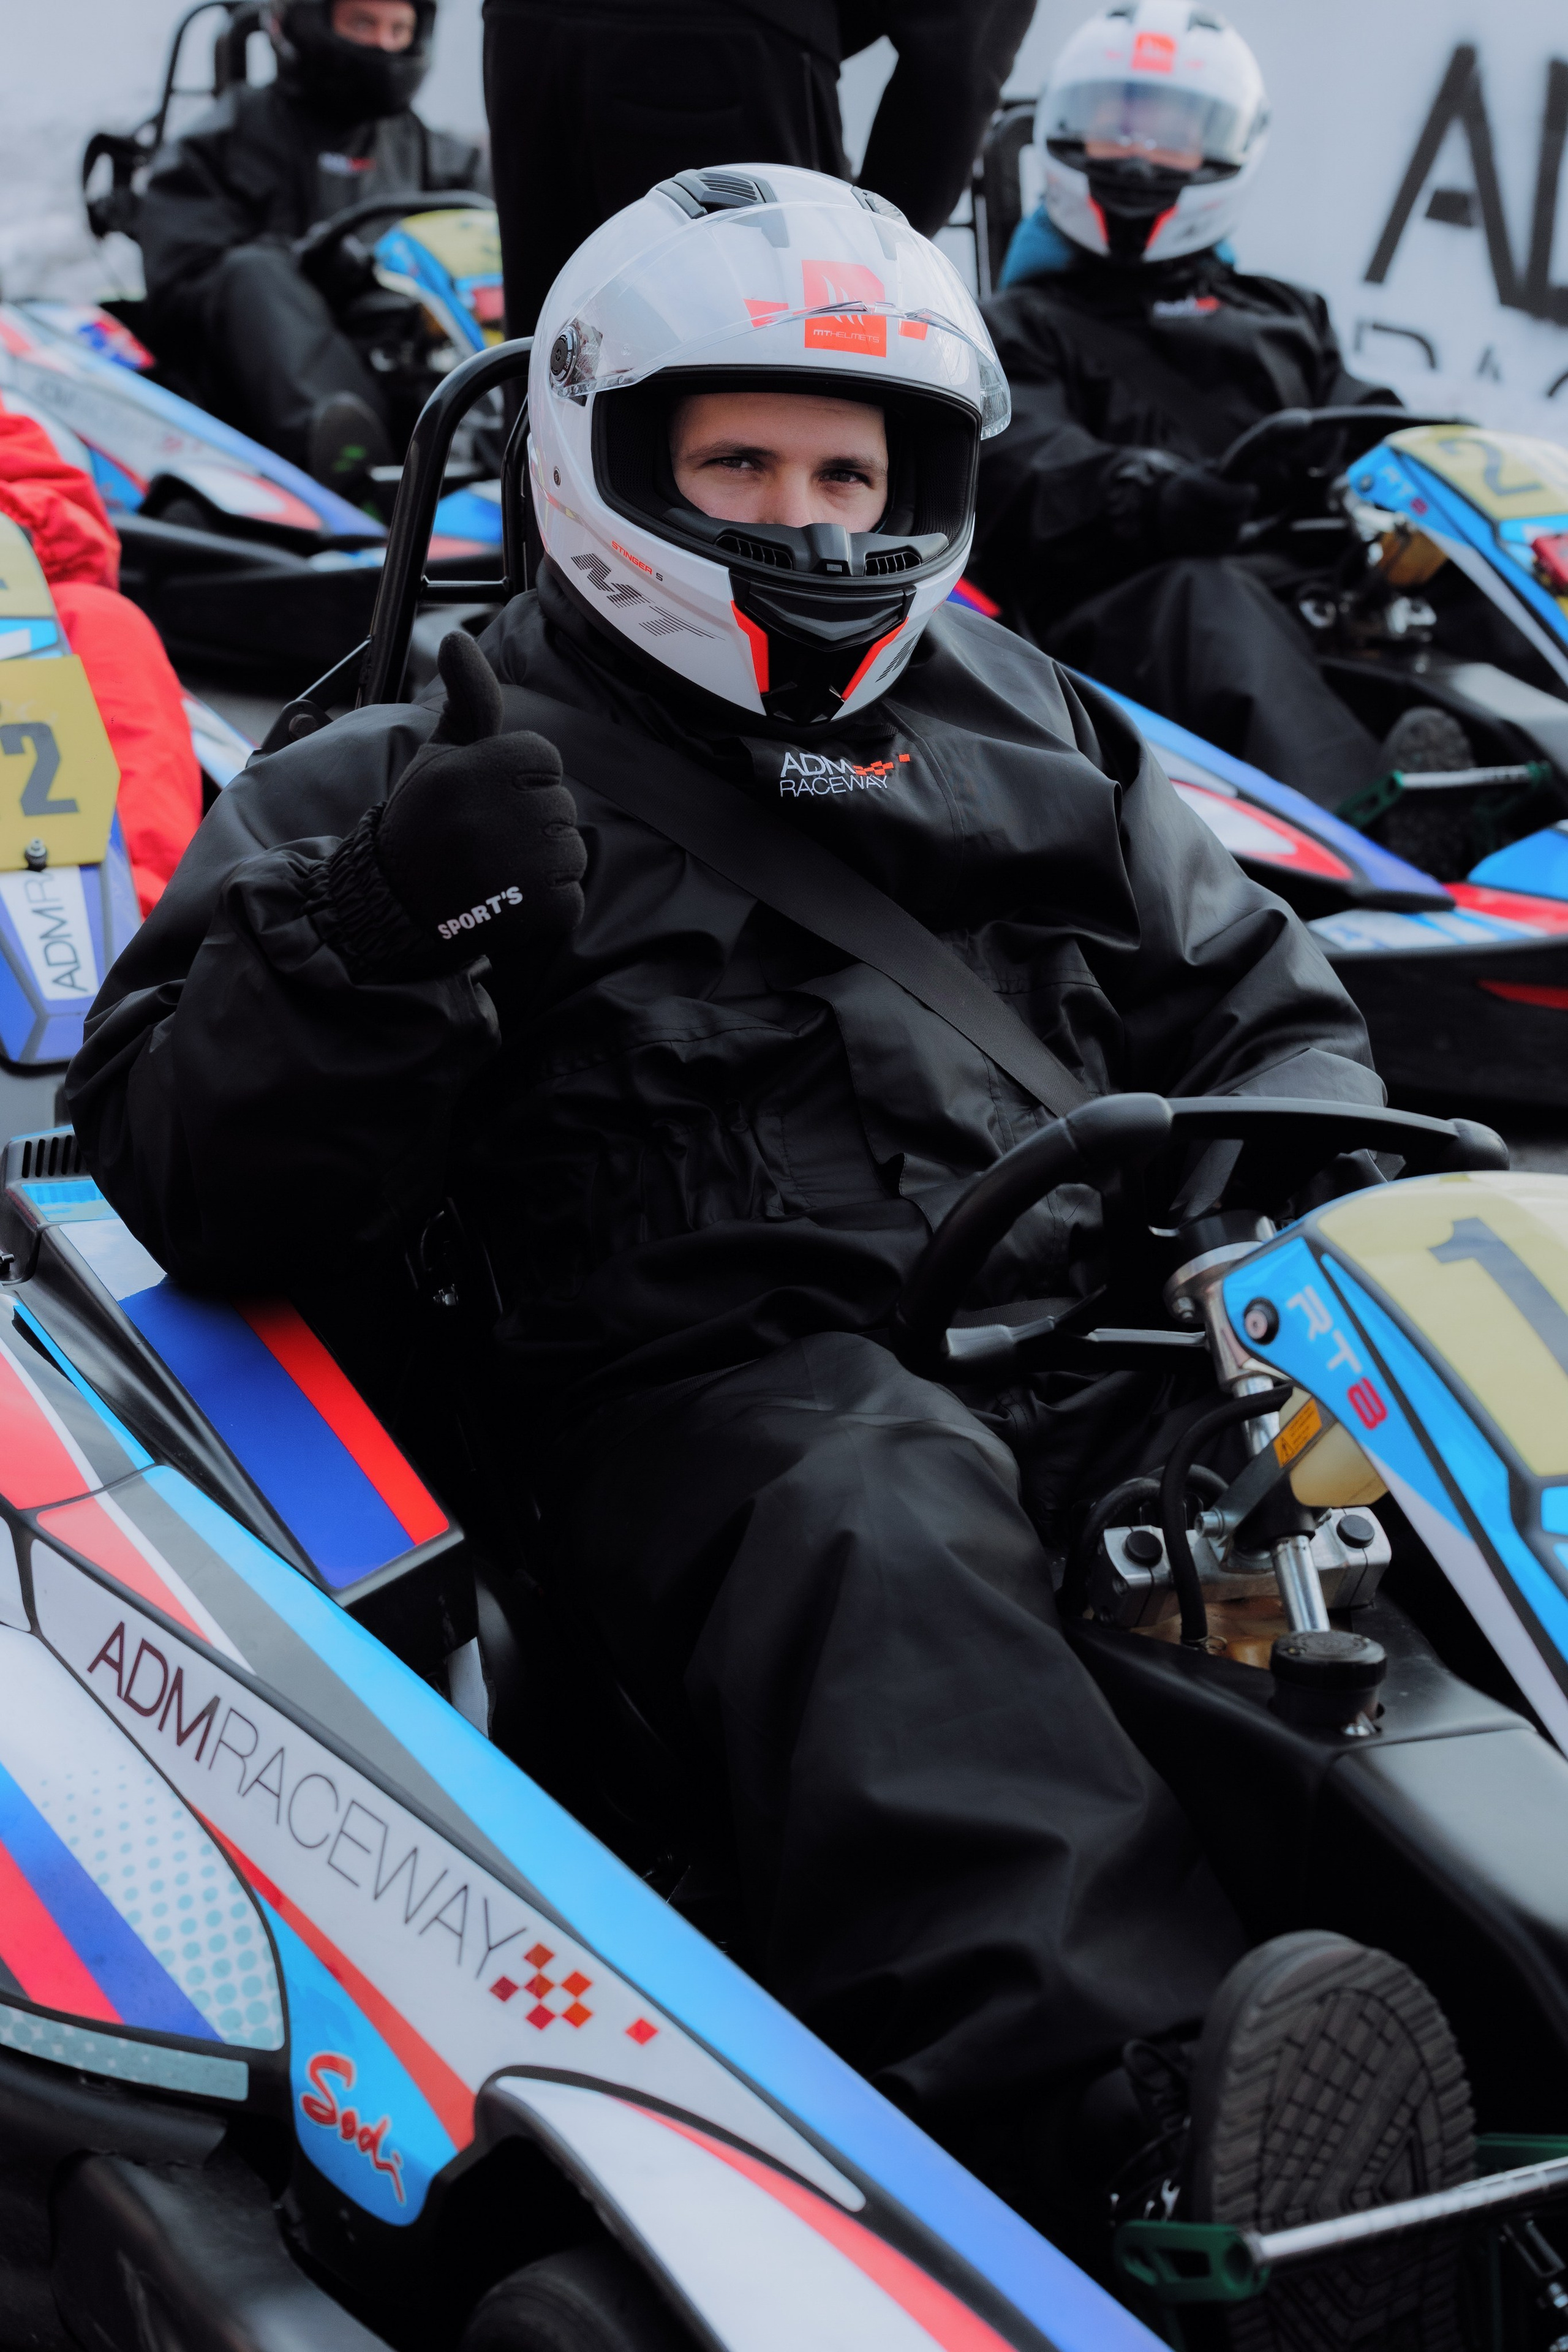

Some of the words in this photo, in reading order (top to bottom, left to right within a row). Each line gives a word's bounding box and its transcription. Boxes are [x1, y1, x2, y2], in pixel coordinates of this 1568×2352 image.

[611, 540, 652, 575] STINGER
[655, 572, 663, 582] S
[780, 752, 856, 778] ADM
[780, 774, 888, 797] RACEWAY
[437, 886, 523, 940] SPORT'S
[299, 2049, 407, 2208] Sodi
